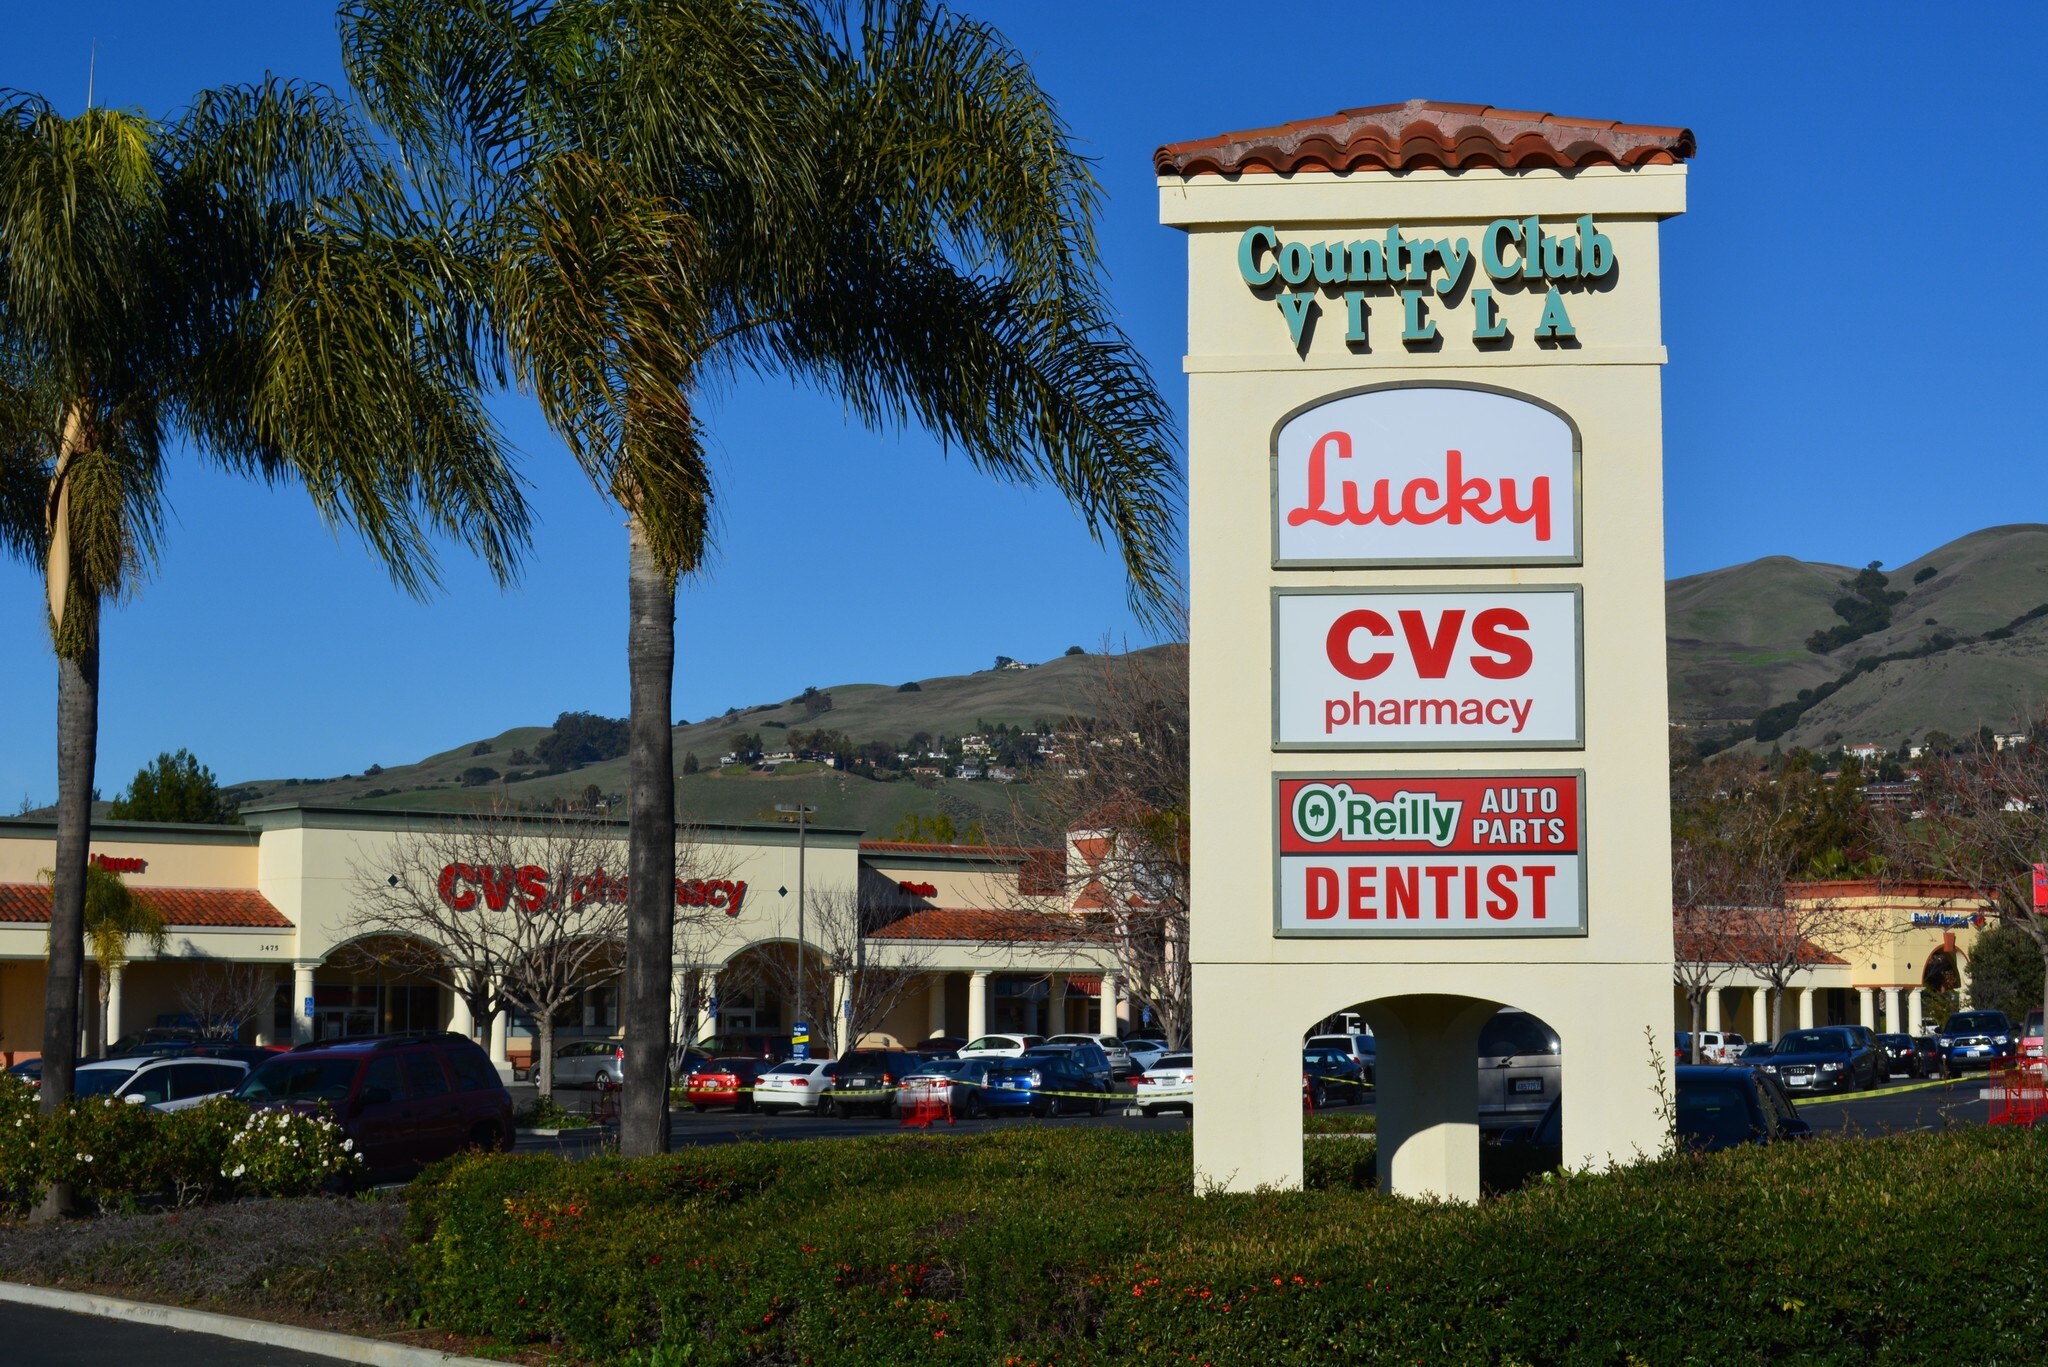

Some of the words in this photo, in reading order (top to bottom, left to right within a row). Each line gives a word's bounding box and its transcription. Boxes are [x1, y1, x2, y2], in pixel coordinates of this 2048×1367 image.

[1237, 223, 1470, 295] Country
[1481, 213, 1615, 281] Club
[1275, 285, 1577, 349] VILLA
[1287, 430, 1551, 541] Lucky
[1325, 607, 1534, 681] CVS
[1325, 691, 1534, 734] pharmacy
[1297, 788, 1456, 841] O'Reilly
[1480, 786, 1559, 815] AUTO
[1471, 817, 1566, 845] PARTS
[1304, 864, 1557, 921] DENTIST
[260, 944, 279, 952] 3475
